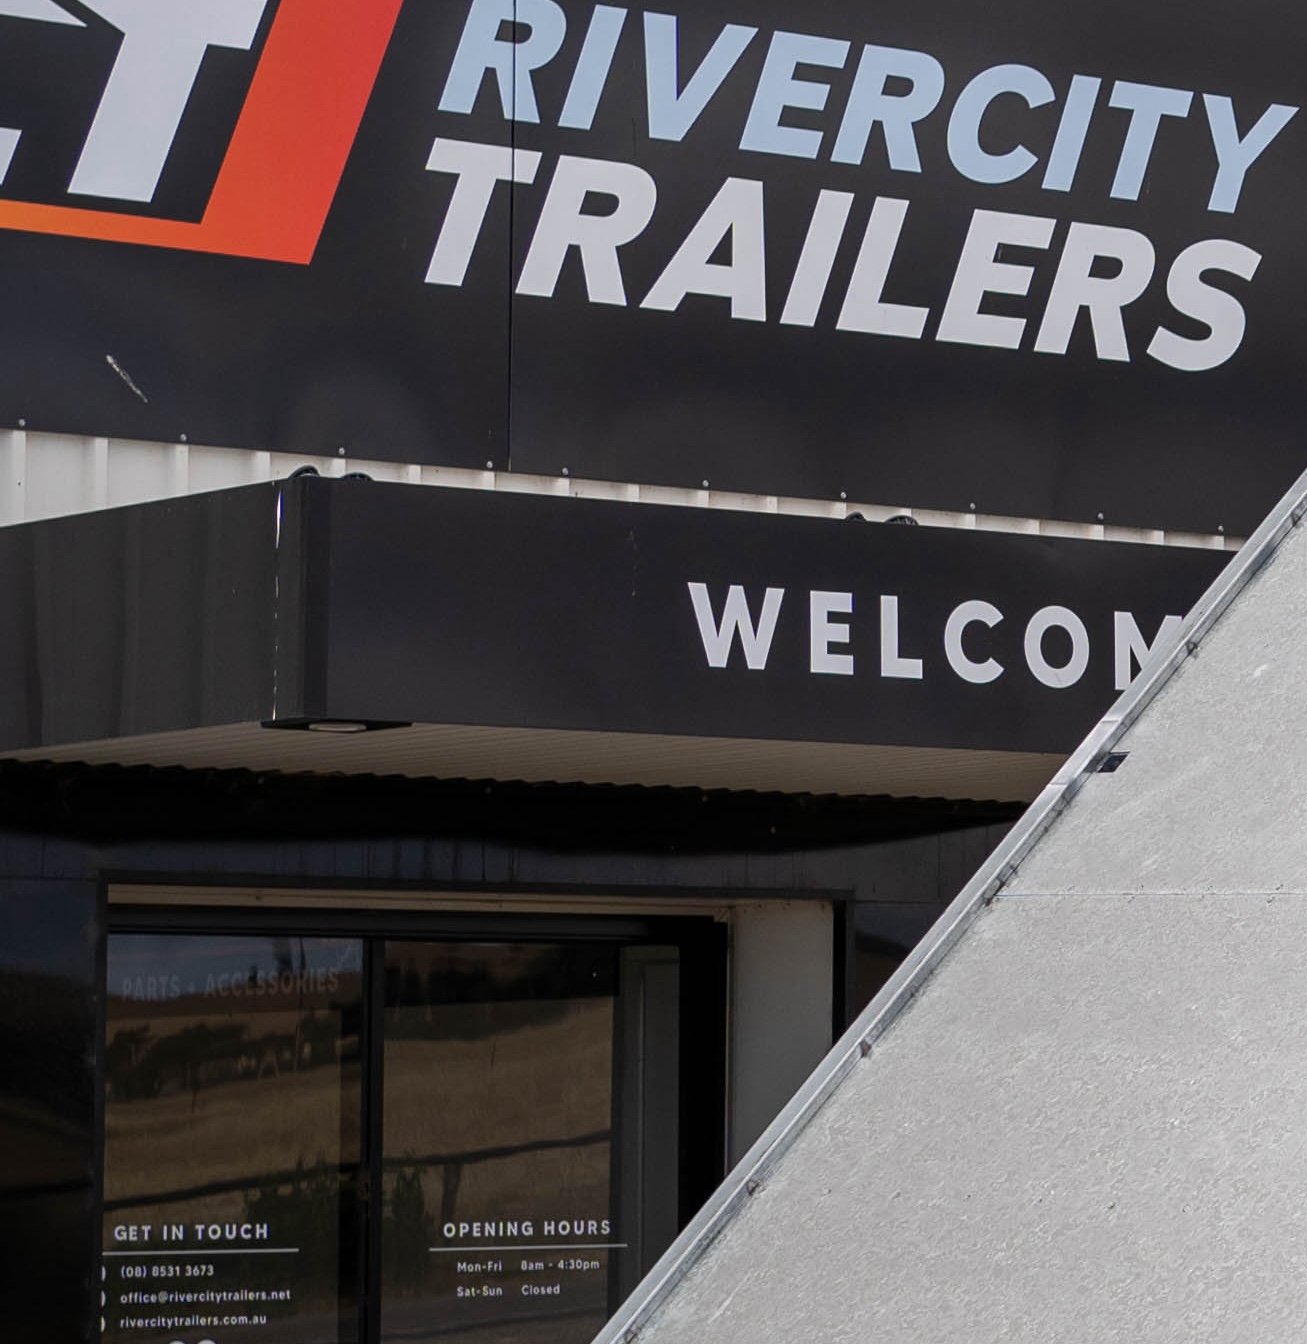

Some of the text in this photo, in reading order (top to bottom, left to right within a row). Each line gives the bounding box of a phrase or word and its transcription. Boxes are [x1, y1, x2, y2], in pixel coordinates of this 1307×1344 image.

[424, 137, 1262, 372] TRAILERS
[122, 968, 339, 1001] PARTS ACCESSORIES
[114, 1223, 269, 1241] GET IN TOUCH
[443, 1220, 611, 1238] OPENING HOURS
[120, 1264, 214, 1278] (08) 8531 3673
[457, 1261, 502, 1272] Mon-Fri
[521, 1260, 544, 1271] 8am
[558, 1259, 600, 1271] 4:30pm
[120, 1289, 291, 1304] office@rivercitytrailers.net
[457, 1284, 560, 1297] Sat-Sun Closed
[120, 1314, 267, 1329] rivercitytrailers.com.au
